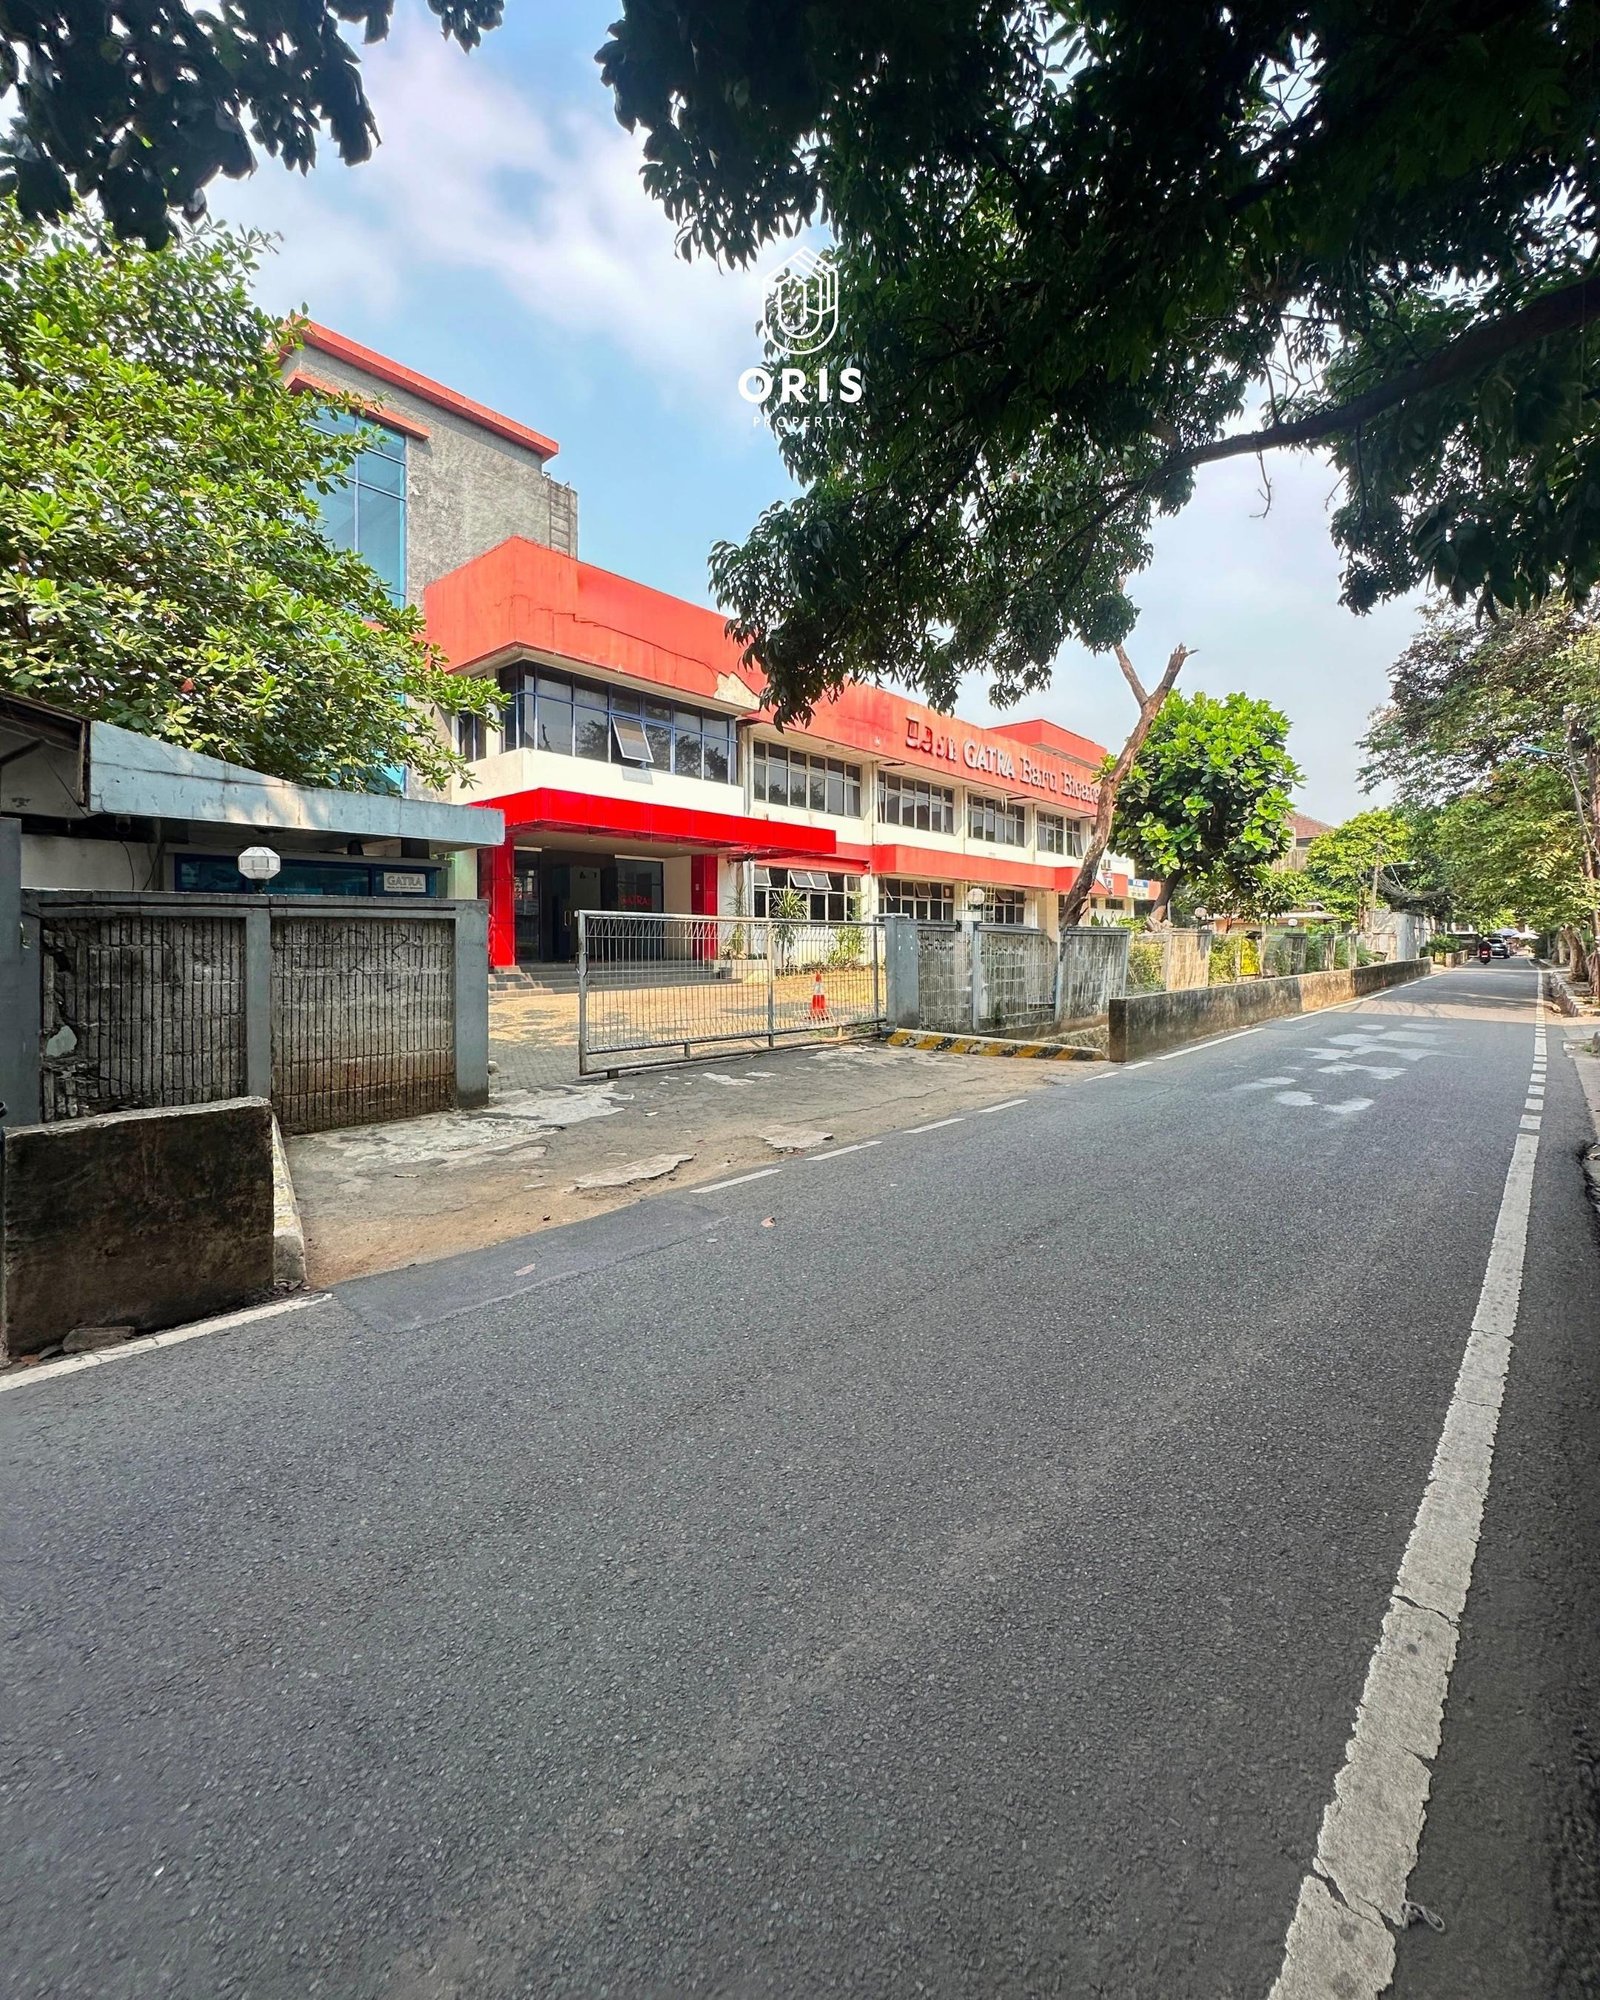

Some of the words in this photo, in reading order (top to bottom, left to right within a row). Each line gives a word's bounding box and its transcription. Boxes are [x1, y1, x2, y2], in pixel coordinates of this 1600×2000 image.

[963, 738, 1015, 781] GATRA
[1019, 757, 1057, 793] Baru
[387, 875, 423, 886] GATRA
